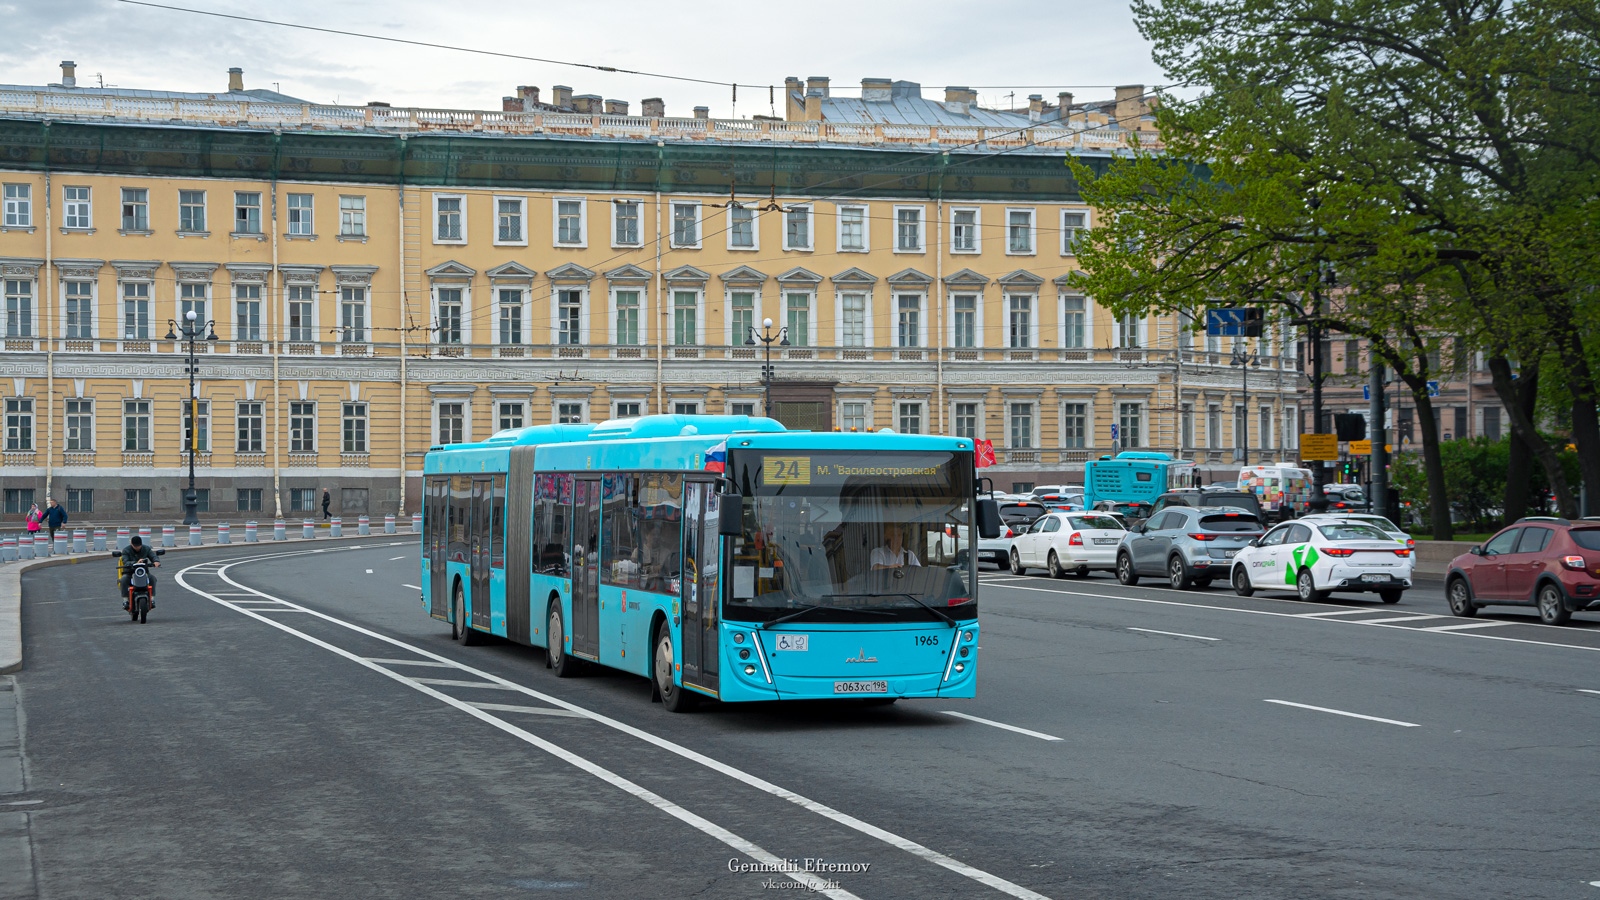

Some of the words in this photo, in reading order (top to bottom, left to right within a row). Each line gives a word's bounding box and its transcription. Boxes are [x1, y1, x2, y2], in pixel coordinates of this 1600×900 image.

[774, 461, 799, 479] 24
[817, 465, 831, 475] М.
[833, 464, 941, 478] "Василеостровская"
[914, 635, 939, 646] 1965
